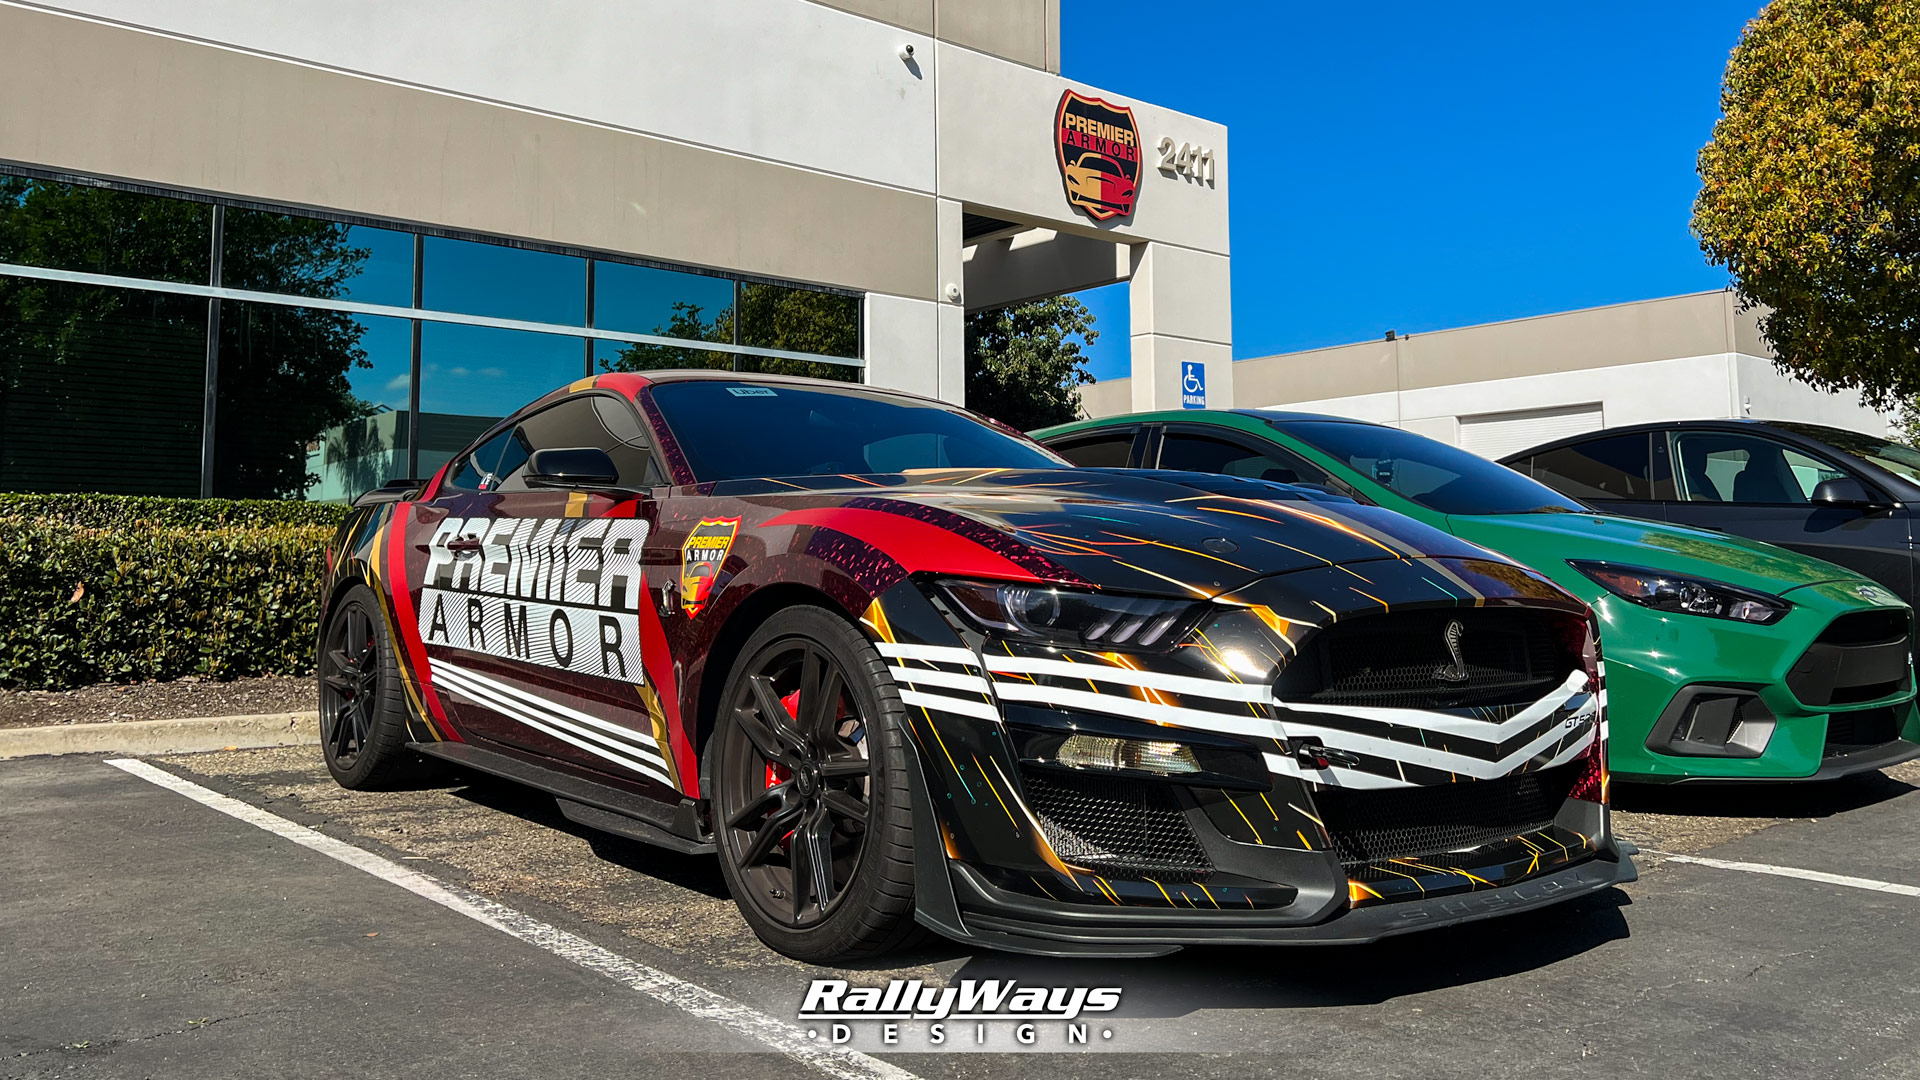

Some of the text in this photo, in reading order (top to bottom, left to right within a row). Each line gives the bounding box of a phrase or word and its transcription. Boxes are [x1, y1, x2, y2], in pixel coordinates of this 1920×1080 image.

[1065, 112, 1135, 147] PREMIER
[1066, 130, 1135, 161] ARMOR
[1157, 136, 1214, 182] 2411
[1183, 394, 1205, 405] PARKING
[686, 549, 725, 561] ARMOR
[687, 536, 731, 549] PREMIER
[423, 517, 650, 610] PREMIER
[428, 593, 628, 678] ARMOR
